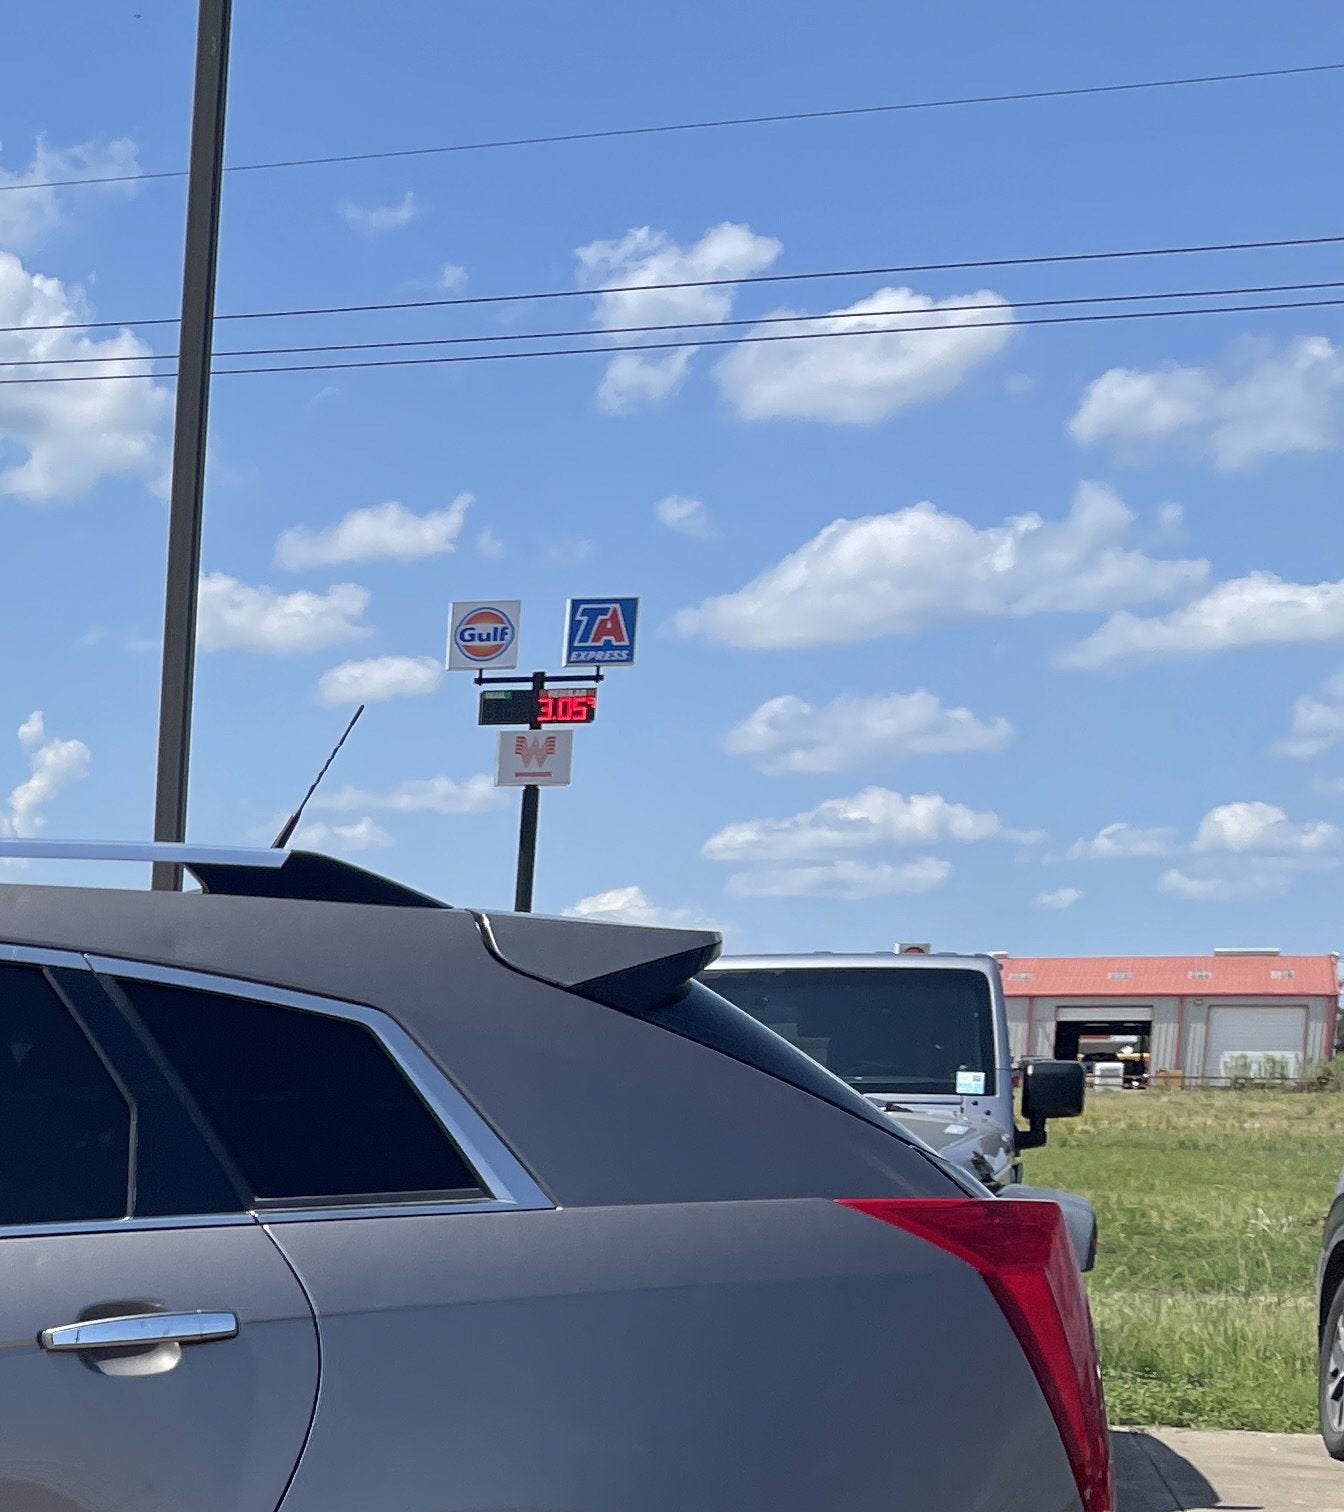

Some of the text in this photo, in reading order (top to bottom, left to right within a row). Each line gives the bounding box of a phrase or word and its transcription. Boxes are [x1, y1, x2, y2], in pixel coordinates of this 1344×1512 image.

[574, 603, 630, 647] TA
[459, 626, 509, 643] Gulf
[569, 650, 630, 662] EXPRESS
